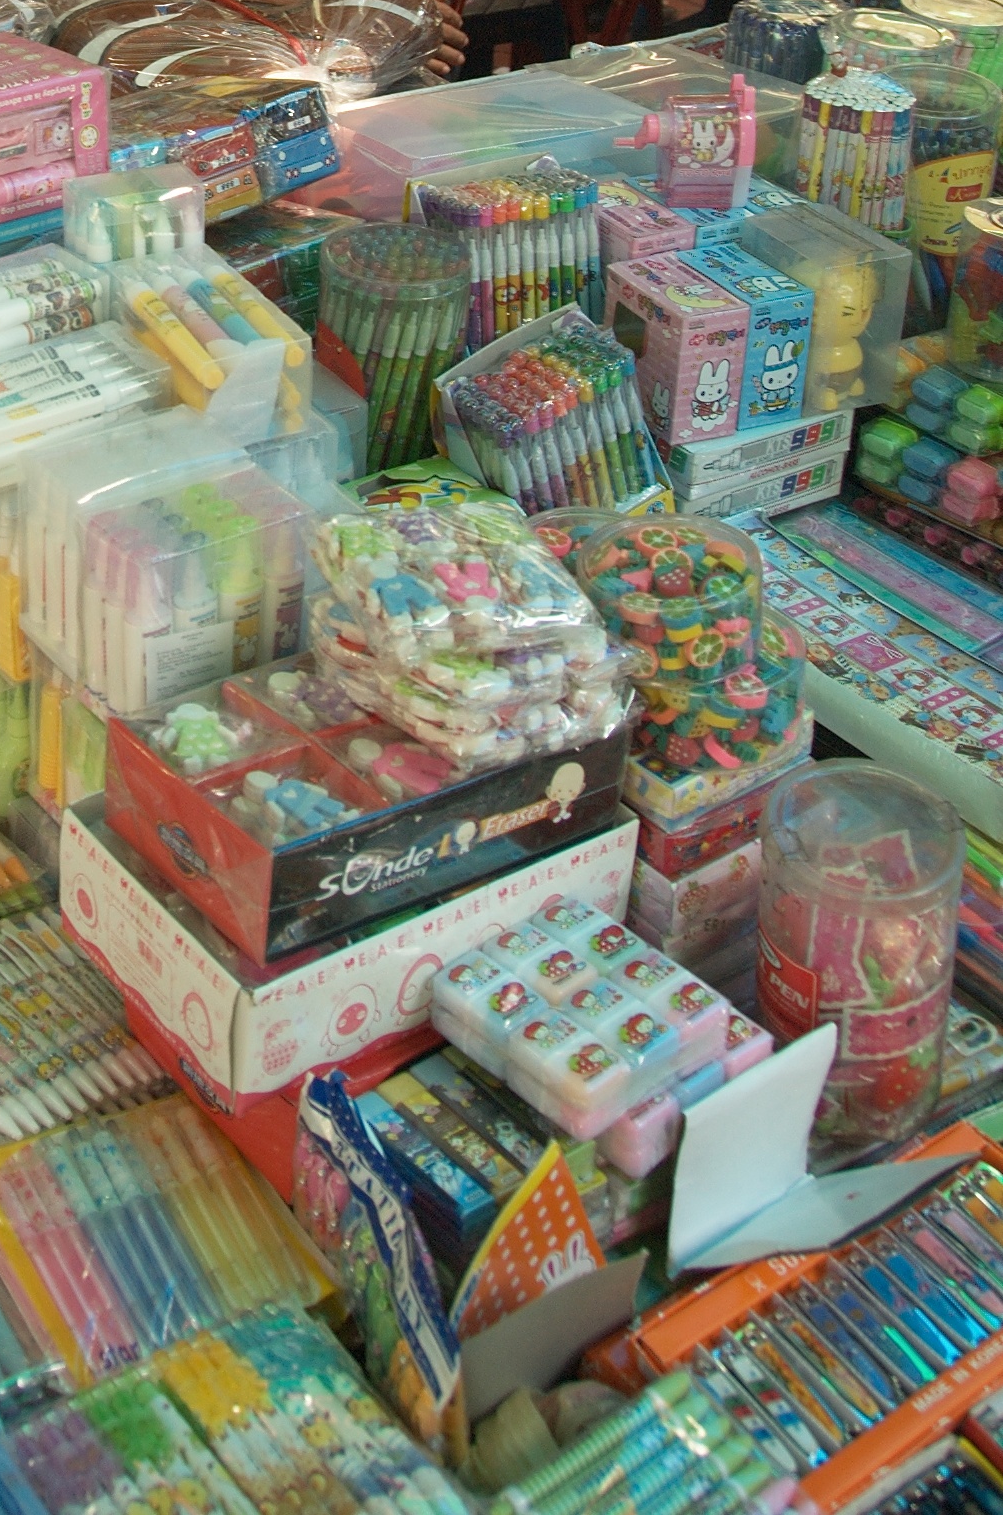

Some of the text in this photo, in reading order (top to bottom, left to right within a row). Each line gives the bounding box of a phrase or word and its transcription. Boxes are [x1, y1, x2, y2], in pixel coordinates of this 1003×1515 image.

[42, 84, 77, 97] Everyday
[0, 206, 16, 216] dog
[16, 200, 45, 212] famous
[484, 802, 547, 838] Eraser
[369, 865, 428, 894] Stationery
[912, 1382, 952, 1413] MADE
[951, 1366, 971, 1384] IN
